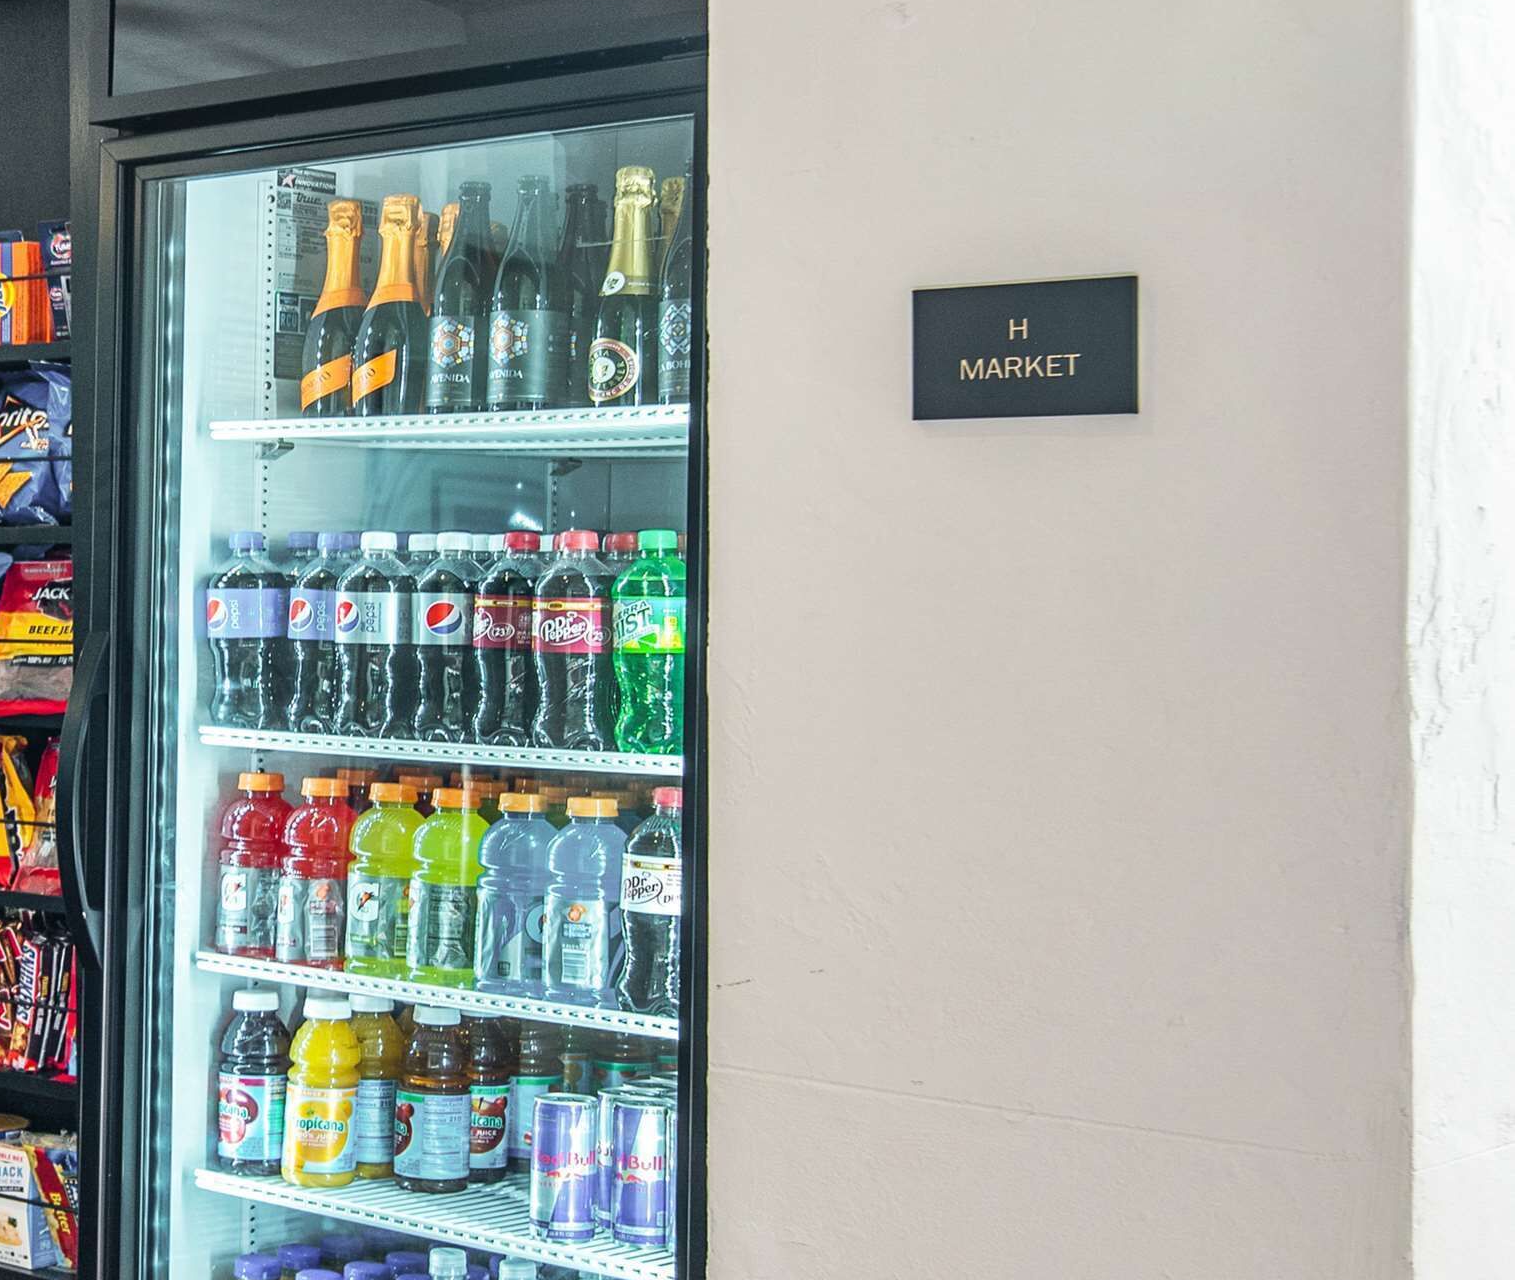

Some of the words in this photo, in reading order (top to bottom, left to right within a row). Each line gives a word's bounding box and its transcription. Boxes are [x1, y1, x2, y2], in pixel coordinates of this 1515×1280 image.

[1008, 318, 1028, 340] H
[959, 353, 1082, 380] MARKET
[32, 587, 71, 601] JACK
[230, 599, 240, 630] pepsi
[316, 600, 327, 632] pepsi
[365, 601, 377, 633] pepsi
[28, 625, 58, 635] BEEF
[545, 619, 586, 642] Pepper
[632, 875, 648, 888] Dr
[567, 1151, 596, 1167] Bull
[627, 1156, 663, 1171] Bull
